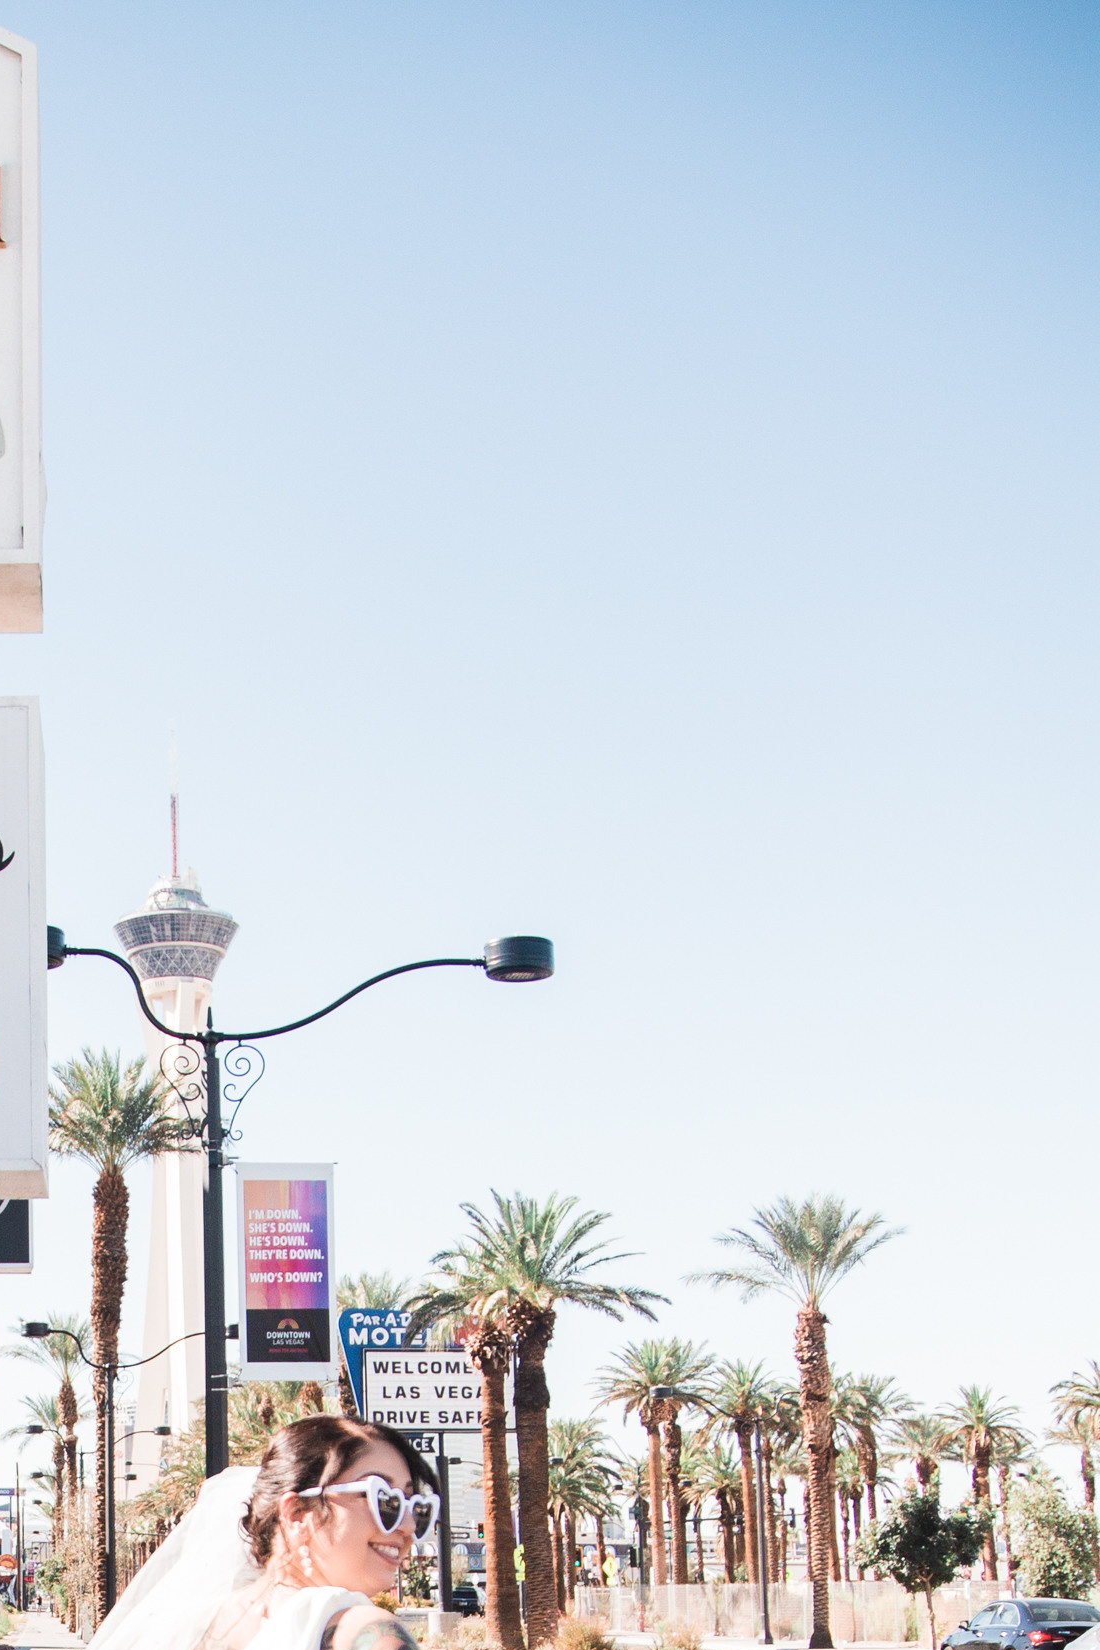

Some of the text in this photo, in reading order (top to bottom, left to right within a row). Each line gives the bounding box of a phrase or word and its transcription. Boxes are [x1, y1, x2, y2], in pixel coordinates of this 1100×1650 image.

[248, 1209, 302, 1219] I'M DOWN.
[248, 1222, 313, 1233] SHE'S DOWN.
[249, 1235, 308, 1246] HE'S DOWN.
[249, 1248, 324, 1260] THEY'RE DOWN.
[249, 1271, 323, 1283] WHO'S DOWN?
[266, 1331, 311, 1339] DOWNTOWN
[373, 1361, 473, 1374] WELCOME
[382, 1386, 420, 1399] LAS
[373, 1411, 430, 1424] DRIVE
